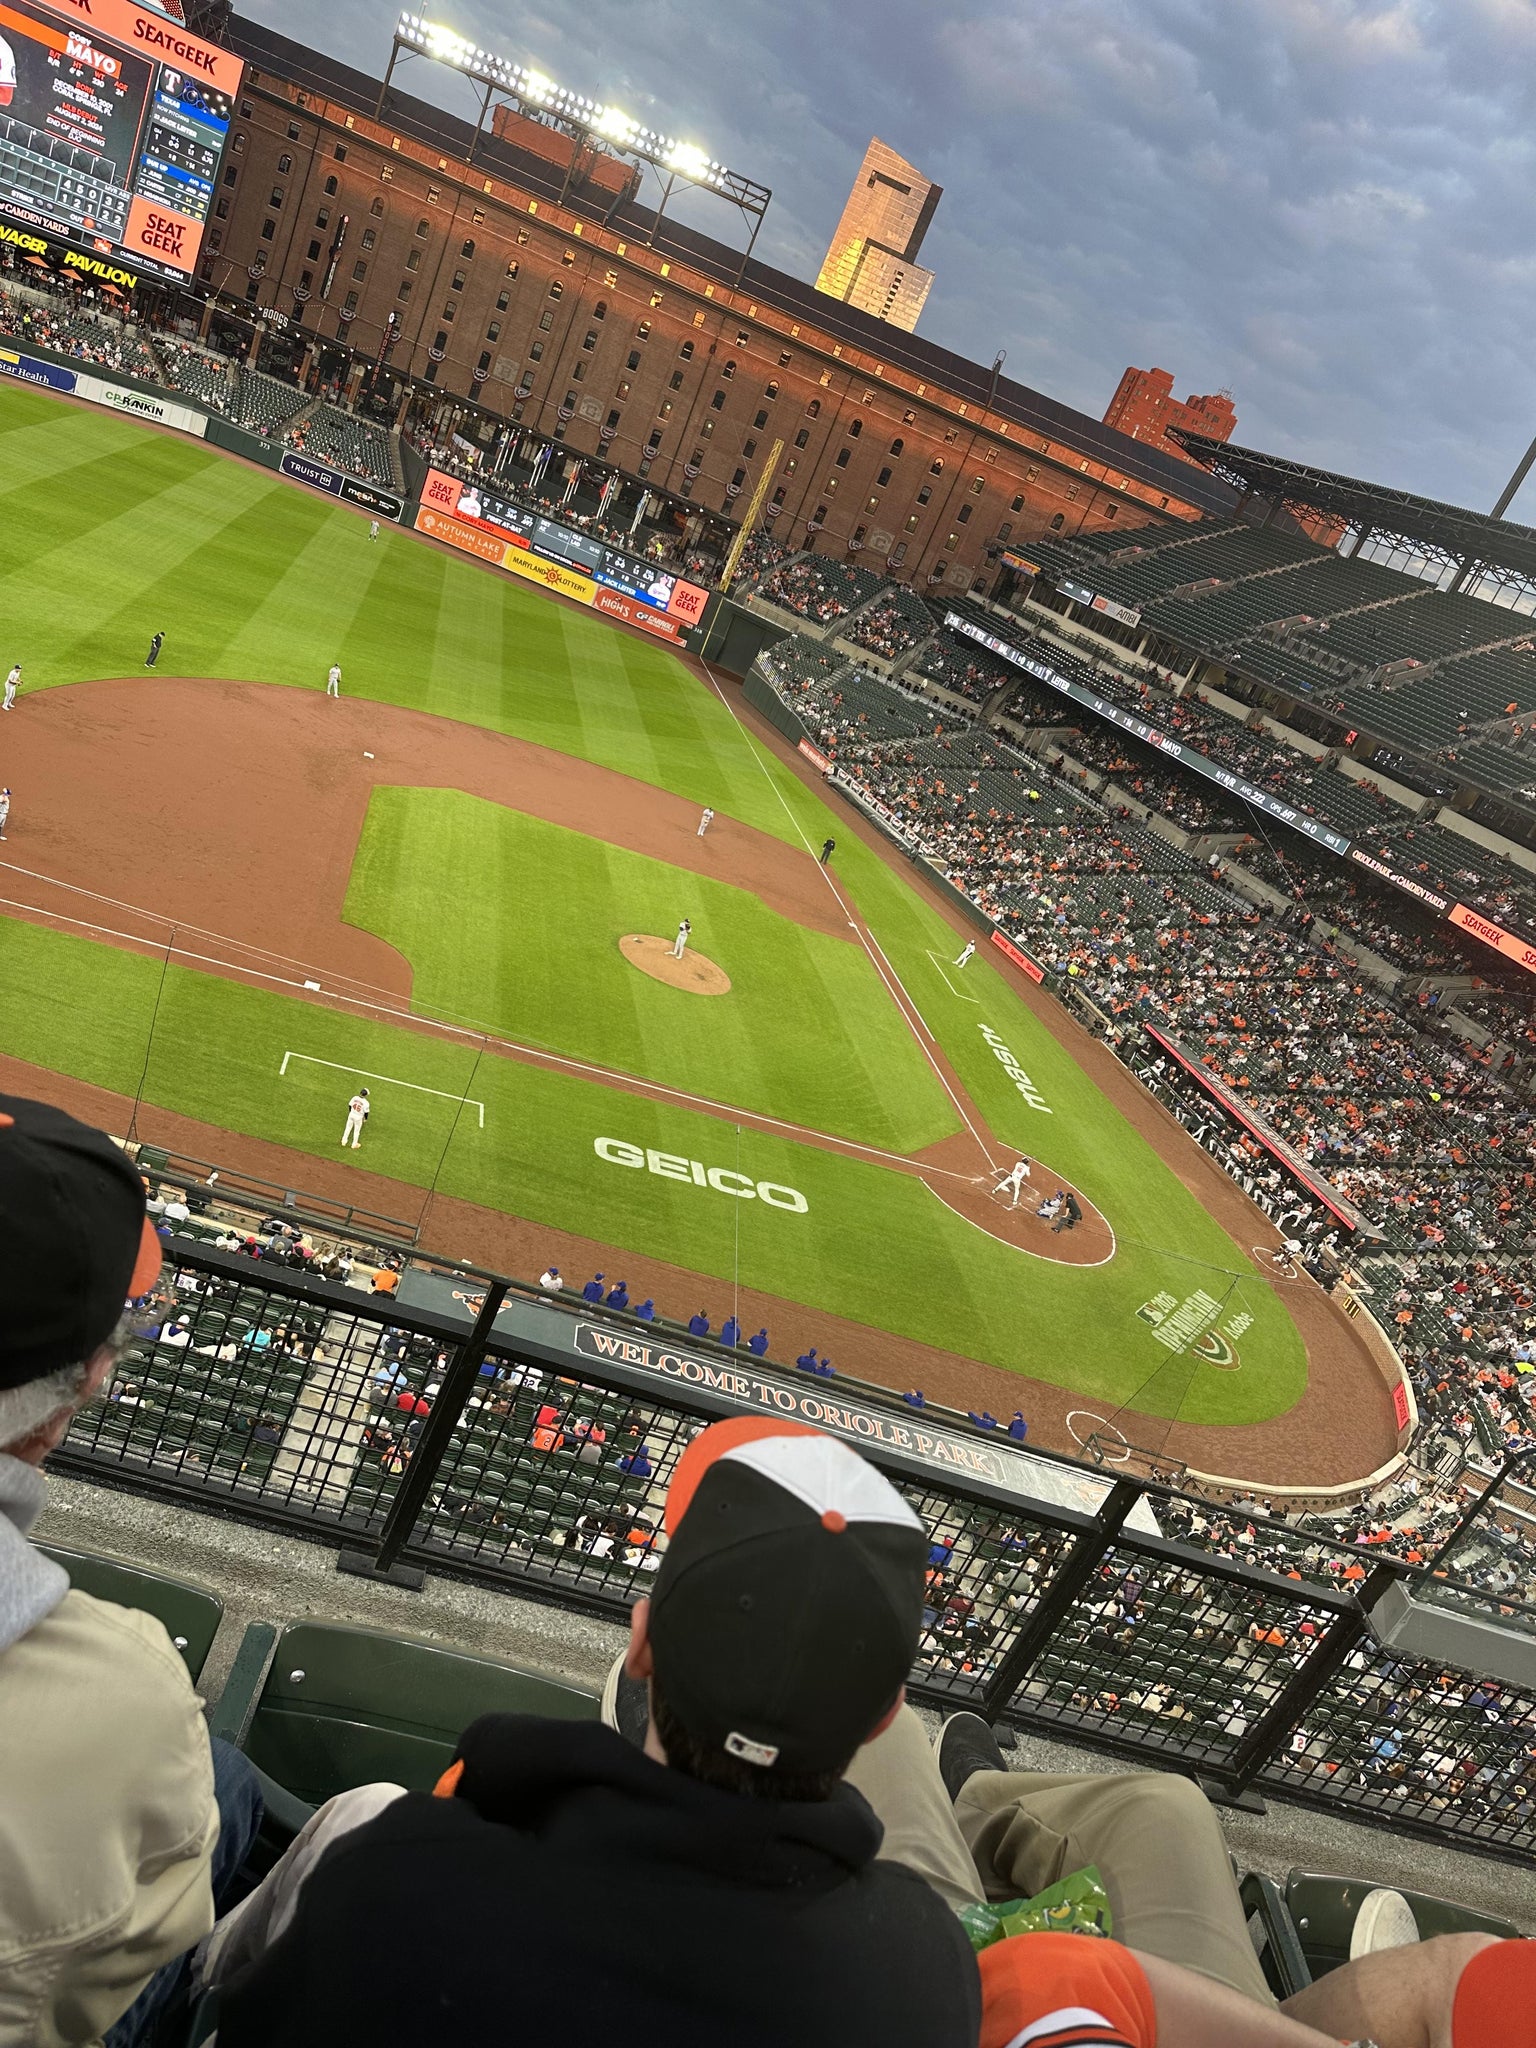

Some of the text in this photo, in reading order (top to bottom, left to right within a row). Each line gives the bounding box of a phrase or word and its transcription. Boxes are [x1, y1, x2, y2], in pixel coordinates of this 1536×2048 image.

[66, 39, 116, 73] MAYO
[133, 18, 218, 76] SEATGEEK
[54, 78, 89, 100] DECEMBER
[165, 68, 181, 93] T
[52, 84, 75, 101] CORAL
[104, 107, 112, 117] FL
[54, 105, 82, 123] AUGUST
[46, 116, 106, 147] END OF BEGINNING
[63, 180, 125, 211] 4 5 0 3 2
[5, 203, 70, 235] CAMDEN YARDS
[62, 194, 122, 225] 1 2 1 2 2
[69, 213, 84, 224] OUT
[146, 213, 187, 240] SEAT
[141, 230, 184, 259] GEEK
[64, 250, 138, 289] PAVILION
[119, 250, 159, 271] CURRENT TOTAL
[18, 367, 51, 385] Health
[290, 461, 320, 480] TRUIST
[428, 489, 452, 506] GEEK
[432, 480, 454, 496] SEAT
[437, 521, 501, 553] AUTUMN LAKE
[478, 521, 495, 533] MAYO
[486, 514, 523, 535] FIRST AT-BAT
[513, 556, 587, 594] MARYLAND LOTTERY
[604, 577, 618, 588] JACK
[618, 583, 636, 596] LEITER
[675, 600, 698, 614] GEEK
[679, 590, 701, 605] SEAT
[601, 596, 630, 618] HIGH'S
[648, 615, 675, 631] CARROLL
[1051, 674, 1070, 692] LEITER
[1161, 738, 1182, 756] MAYO
[1215, 770, 1340, 848] B/T R/R AVG .222 OPS .697 HR 0 RBI 1
[1352, 850, 1378, 870] ORIOLE
[1375, 862, 1393, 879] PARK
[1396, 875, 1425, 900] CAMDEN
[1424, 890, 1447, 910] YARDS
[1462, 914, 1504, 946] SEATGEEK
[977, 1023, 1053, 1114] masn+
[594, 1136, 809, 1214] GEICO
[1151, 1290, 1179, 1315] 2026
[1223, 1311, 1255, 1340] Adobe
[591, 1331, 994, 1475] WELCOME TO ORIOLE PARK
[543, 1436, 551, 1447] 2
[1297, 1737, 1304, 1749] 2
